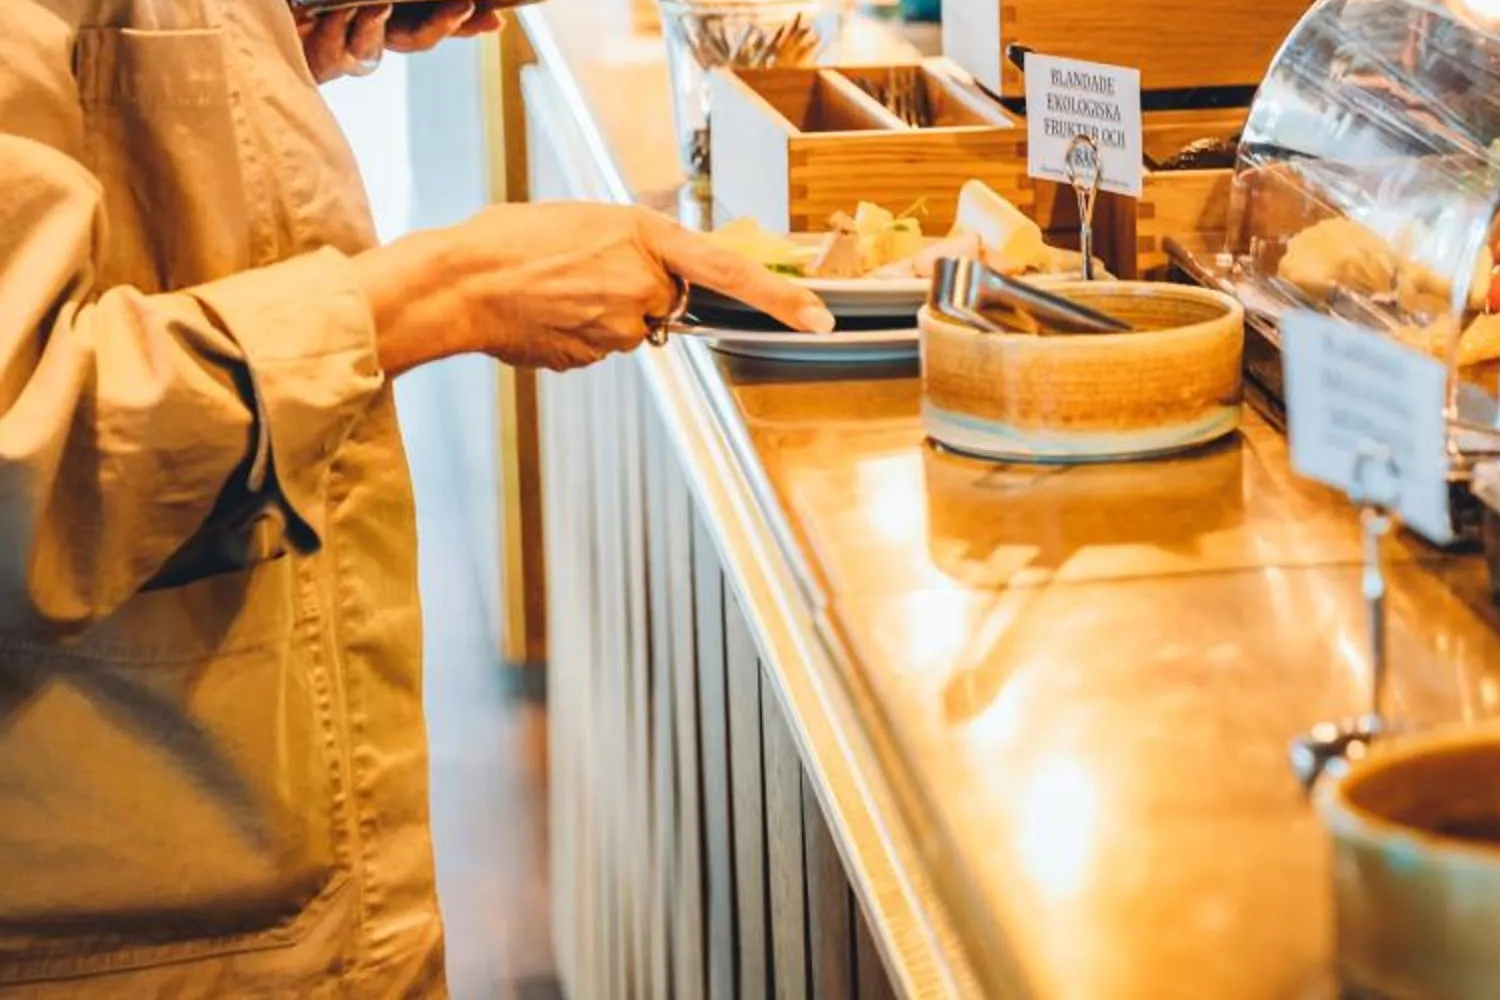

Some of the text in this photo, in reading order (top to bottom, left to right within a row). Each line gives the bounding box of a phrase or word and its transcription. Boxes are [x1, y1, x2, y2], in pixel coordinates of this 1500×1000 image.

[1050, 69, 1115, 95] BLANDADE
[1046, 92, 1121, 121] EKOLOGISKA
[1101, 127, 1125, 149] OCH
